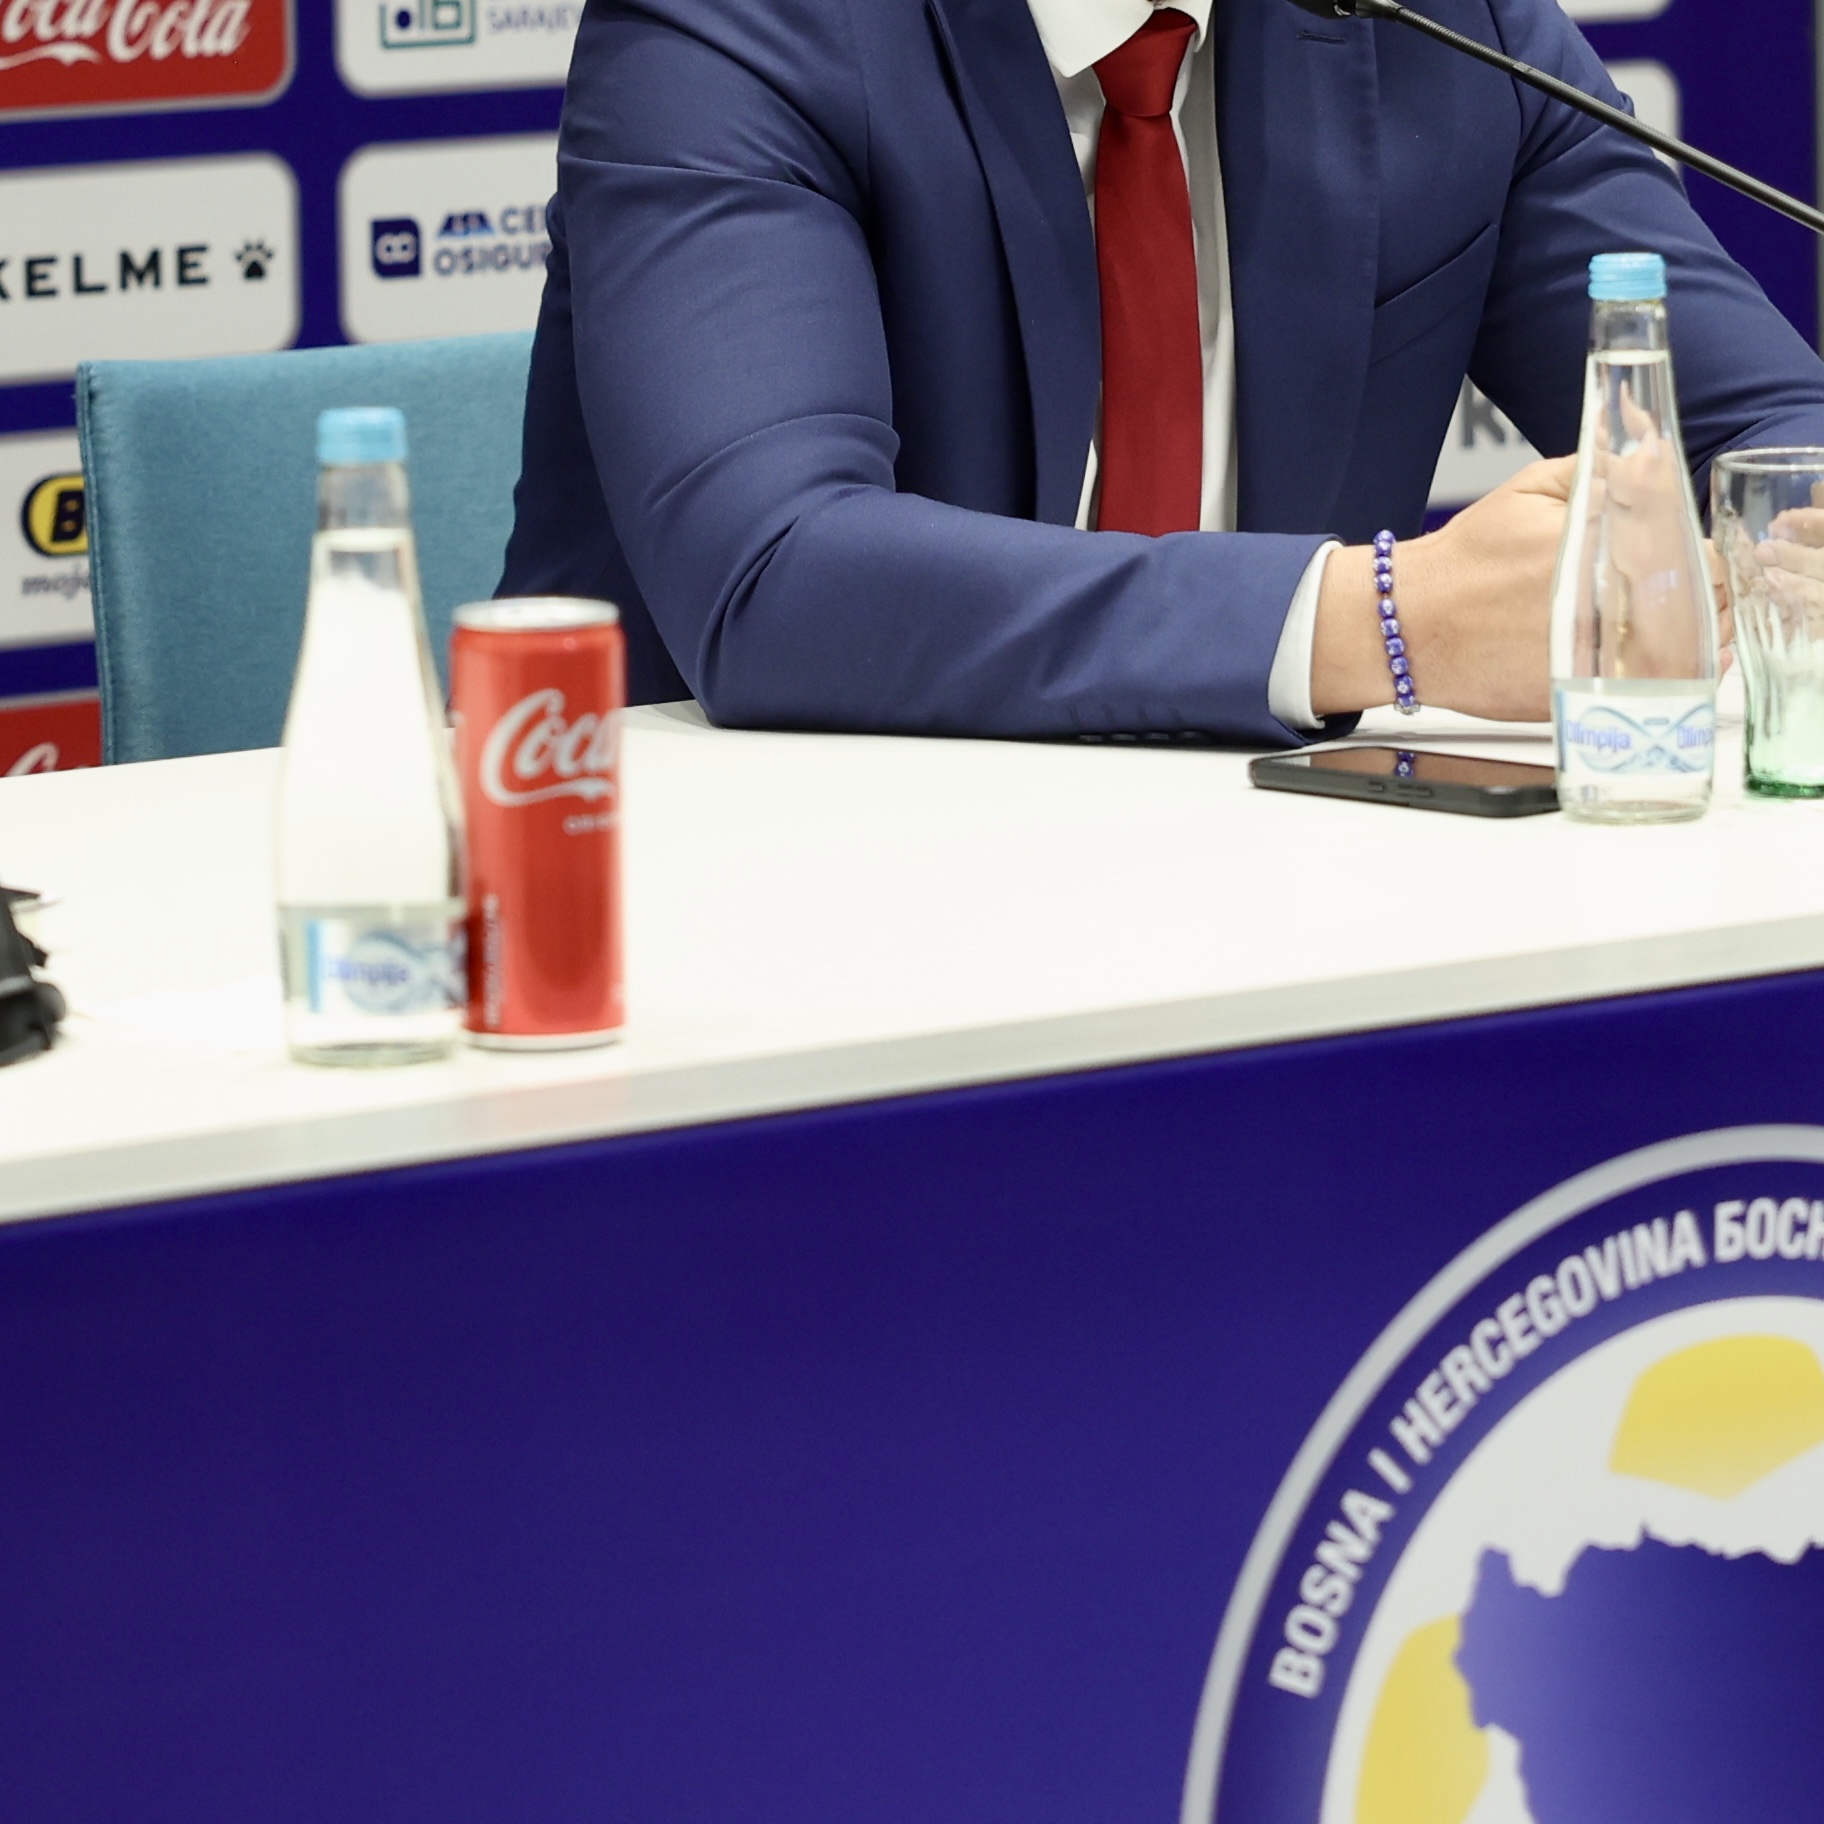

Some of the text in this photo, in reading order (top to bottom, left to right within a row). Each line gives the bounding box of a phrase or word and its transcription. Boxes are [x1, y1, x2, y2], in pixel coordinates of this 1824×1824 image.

[1268, 1208, 1708, 1698] BOSNA I HERCEGOVINA
